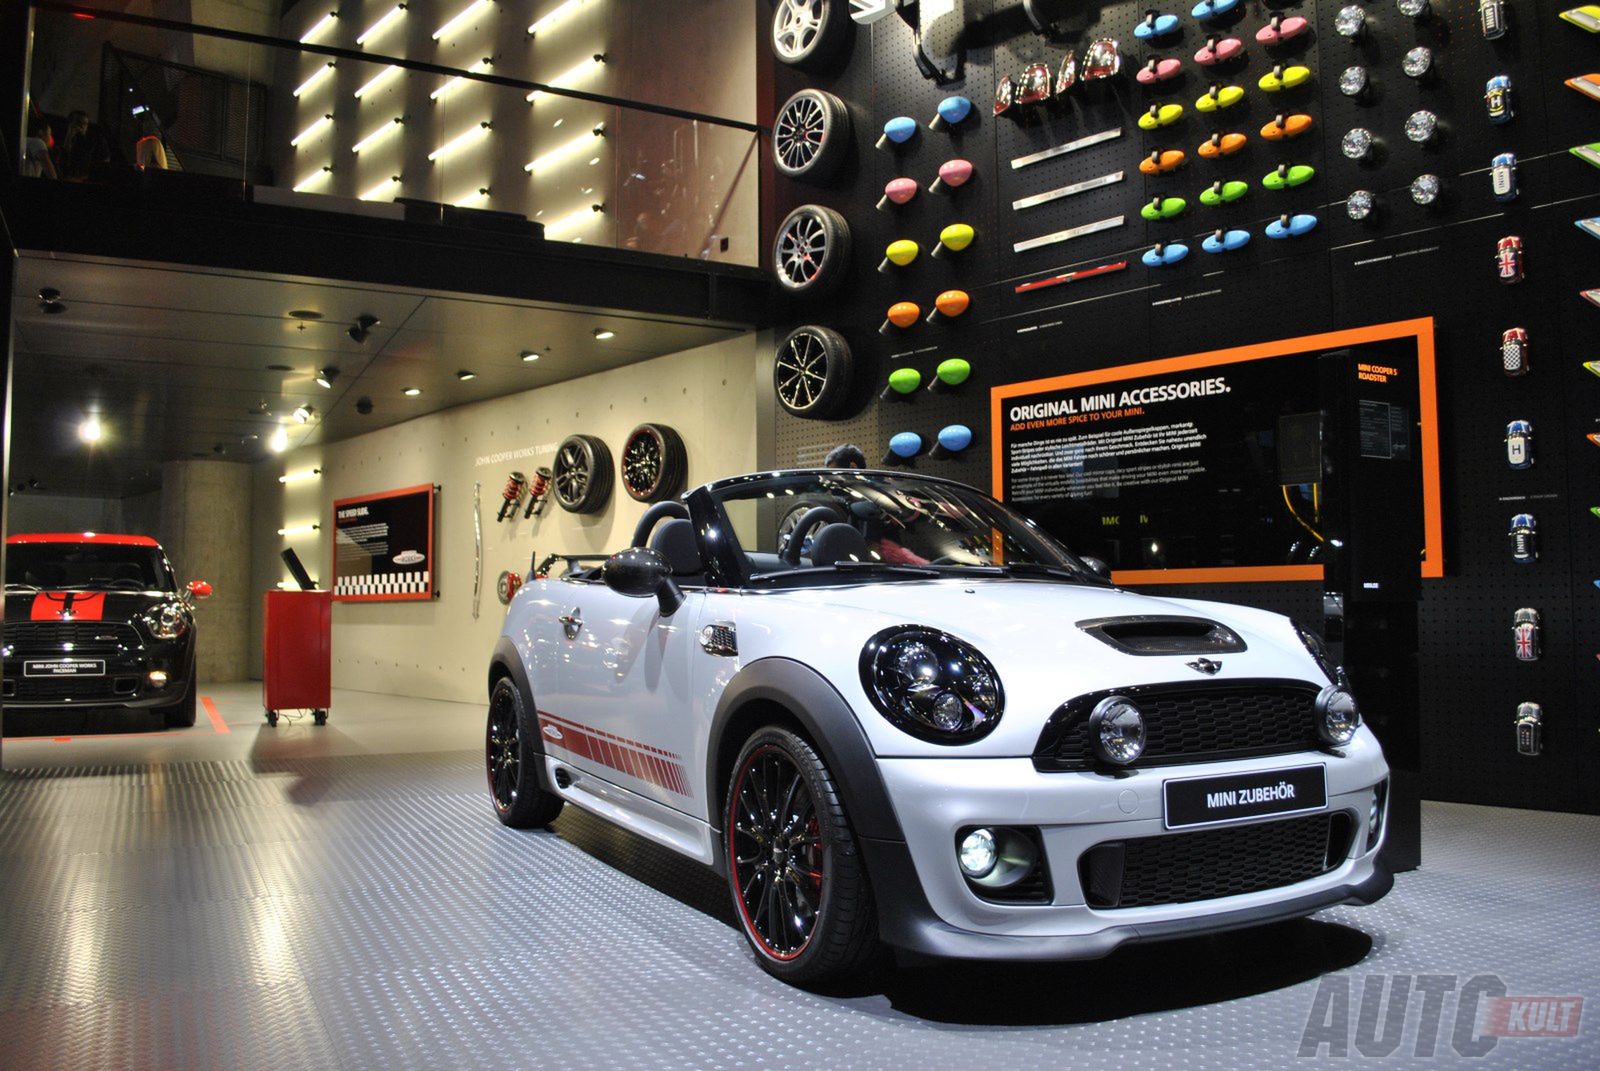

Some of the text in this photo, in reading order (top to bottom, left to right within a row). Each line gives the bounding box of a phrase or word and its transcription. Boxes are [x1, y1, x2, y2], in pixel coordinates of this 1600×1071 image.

[1010, 377, 1231, 421] ORIGINAL MINI ACCESSORIES.
[1010, 407, 1145, 431] ADD EVEN MORE SPICE TO YOUR MINI.
[1512, 444, 1521, 455] H
[1207, 781, 1295, 808] MINI ZUBEHÖR
